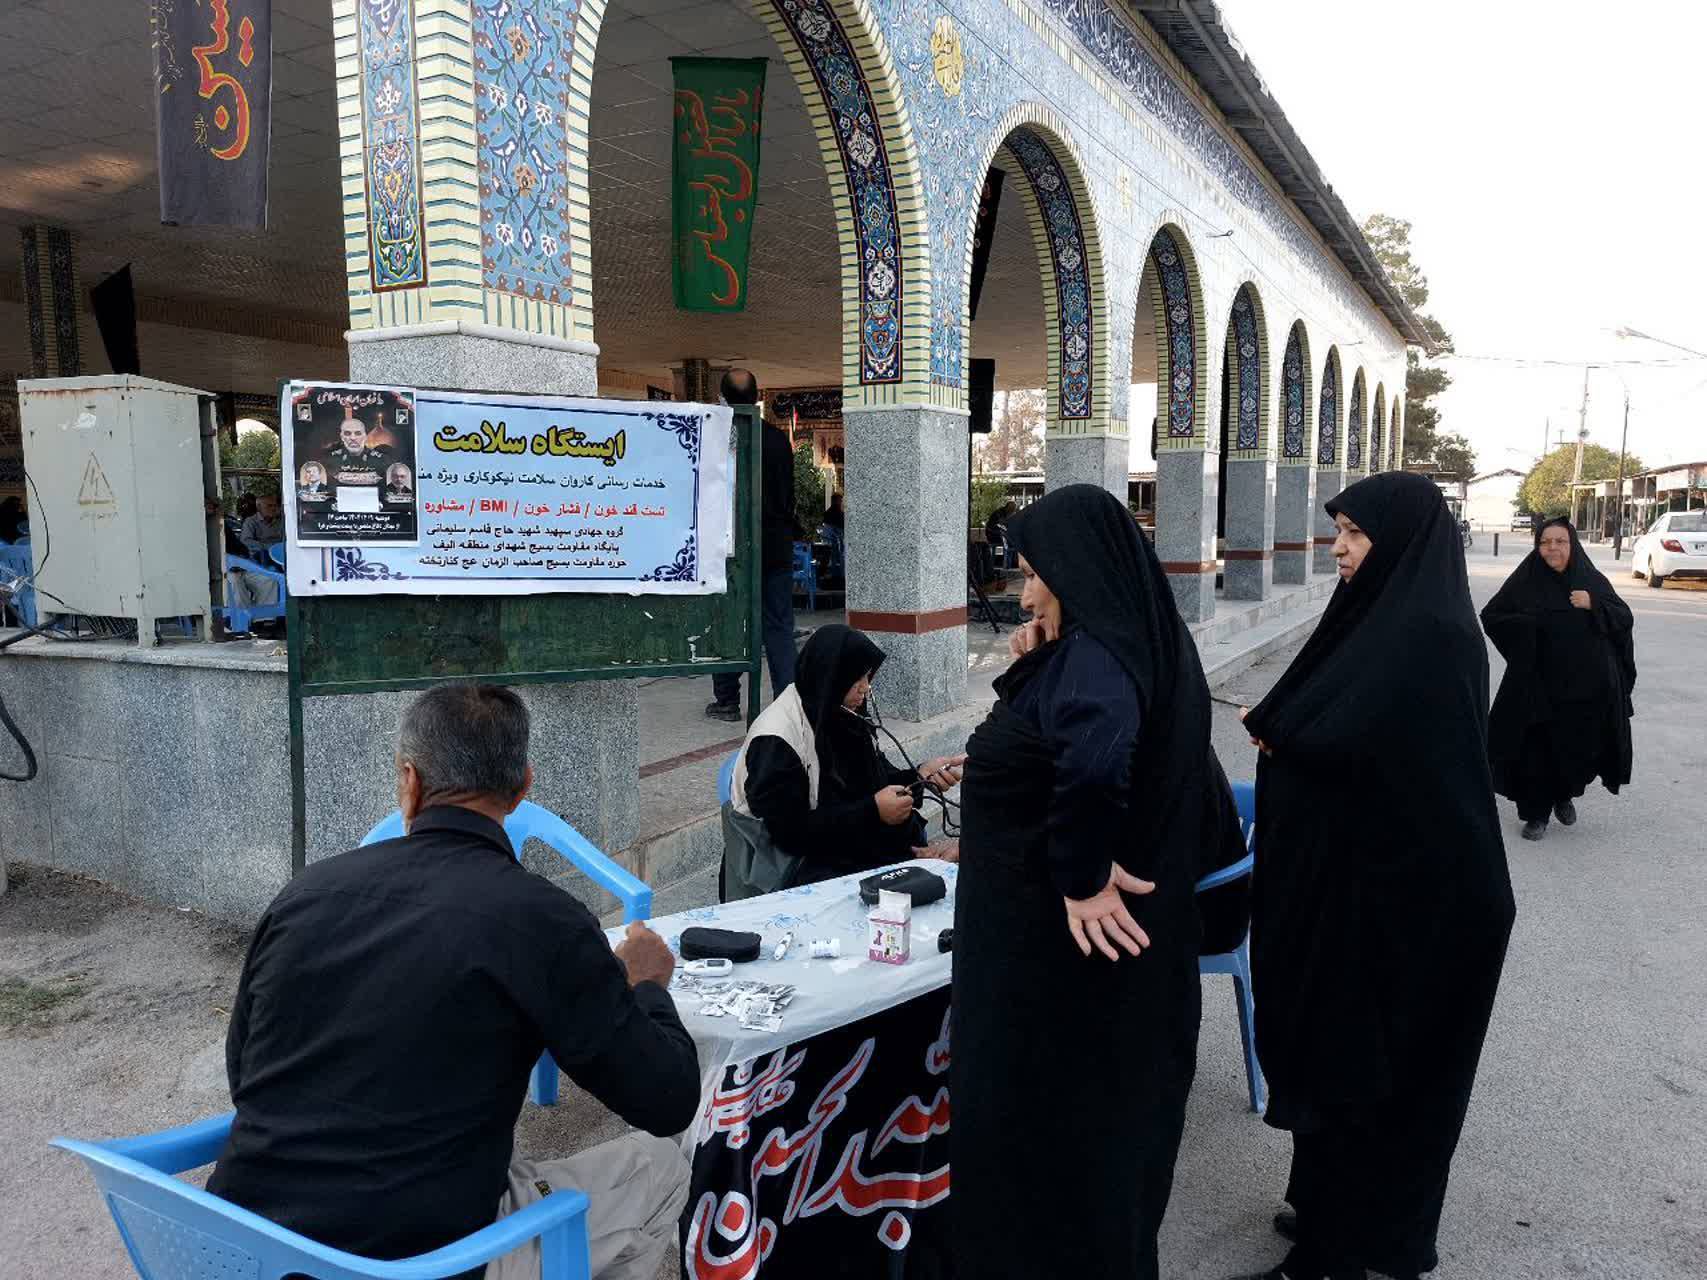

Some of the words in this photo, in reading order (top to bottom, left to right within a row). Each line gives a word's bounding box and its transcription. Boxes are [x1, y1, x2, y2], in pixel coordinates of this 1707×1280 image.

[433, 420, 527, 454] سلامت
[531, 425, 626, 467] ایستگاه
[437, 466, 458, 486] ویژه
[463, 469, 514, 486] نیکوکاری
[518, 471, 556, 485] سلامت
[560, 474, 595, 488] کاروان
[597, 474, 629, 490] رسانی
[632, 474, 666, 489] خدمات
[424, 498, 465, 514] مشاوره
[480, 499, 508, 512] BMI
[524, 502, 550, 516] خون
[556, 502, 581, 517] فشار
[594, 504, 618, 518] خون
[622, 503, 638, 516] قند
[640, 506, 665, 516] تست
[426, 523, 466, 536] سلیمانی
[469, 522, 491, 536] قاسم
[494, 525, 514, 538] حاج
[518, 525, 541, 536] شهید
[545, 526, 571, 539] سپهبد
[575, 526, 603, 538] جهادی
[606, 526, 624, 538] گروه
[459, 540, 490, 550] منطقه
[493, 541, 526, 553] شهدای
[529, 543, 554, 554] بسیج
[557, 541, 591, 553] مقاومت
[594, 541, 620, 554] پایگاه
[482, 556, 509, 569] الزمان
[513, 557, 543, 568] صاحب
[546, 559, 571, 570] بسیج
[573, 557, 605, 569] مقاومت
